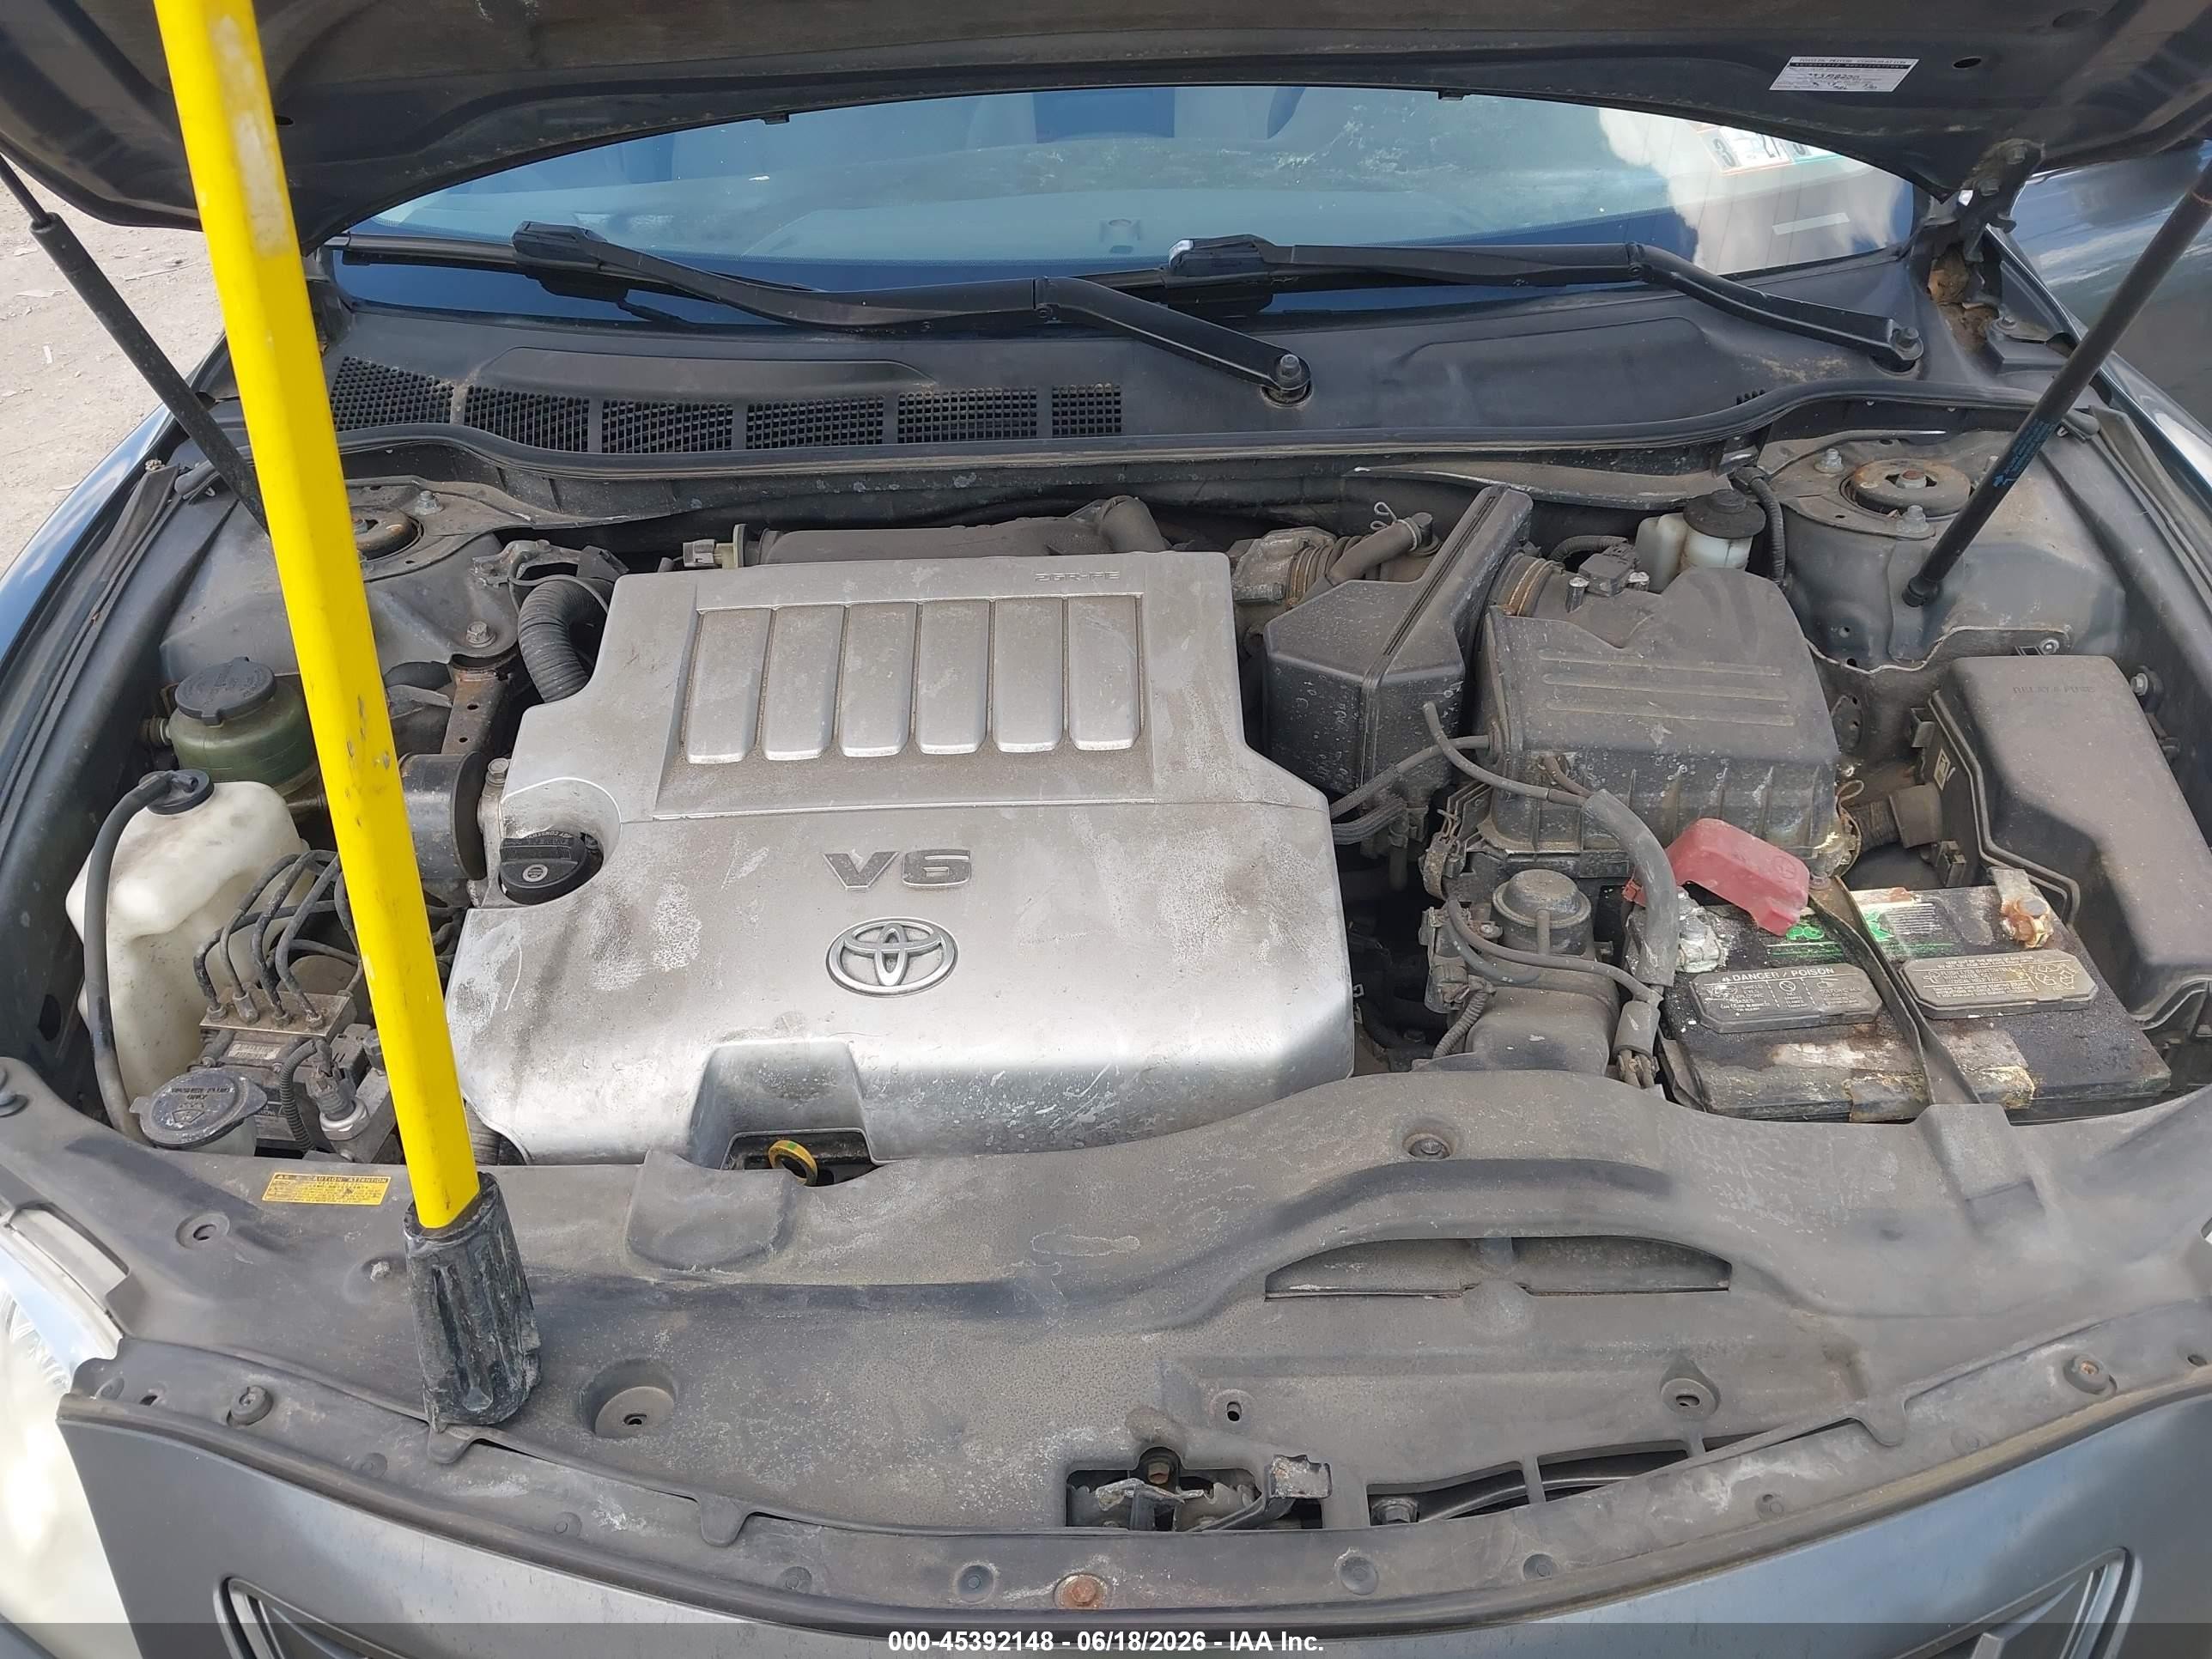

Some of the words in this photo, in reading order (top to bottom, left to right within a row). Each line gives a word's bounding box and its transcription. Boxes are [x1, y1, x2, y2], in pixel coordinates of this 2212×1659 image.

[823, 848, 972, 891] V6
[1733, 971, 1781, 981] DANGER
[1791, 968, 1835, 977] POISON
